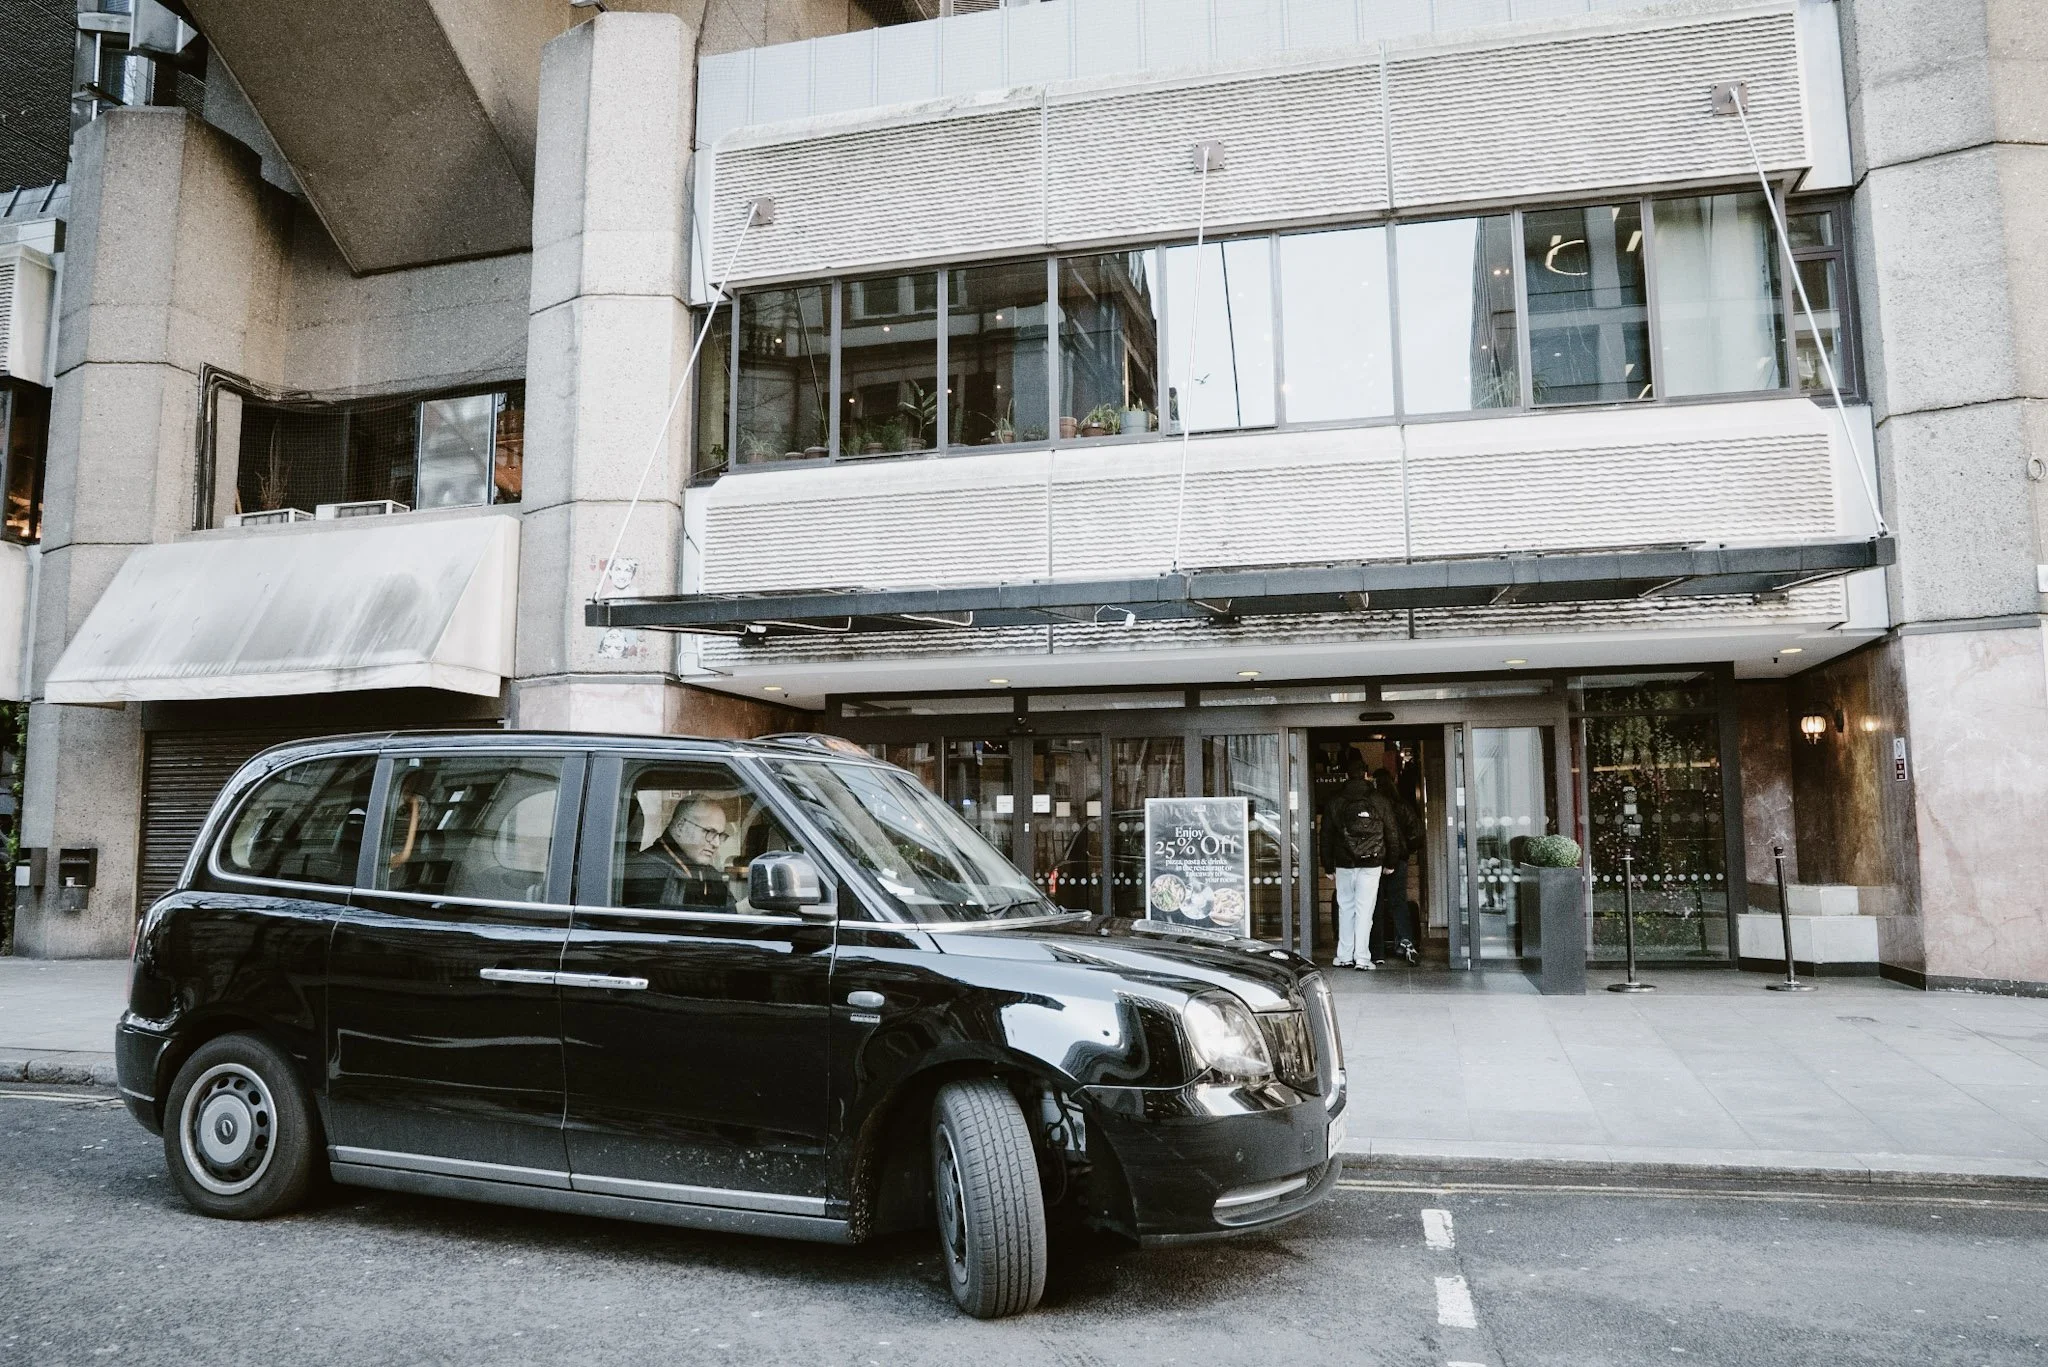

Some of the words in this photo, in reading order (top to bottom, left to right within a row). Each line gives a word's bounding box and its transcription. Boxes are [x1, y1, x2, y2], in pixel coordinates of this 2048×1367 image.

[1175, 827, 1204, 840] Enjoy
[1154, 838, 1196, 859] 25%
[1200, 835, 1239, 855] Off
